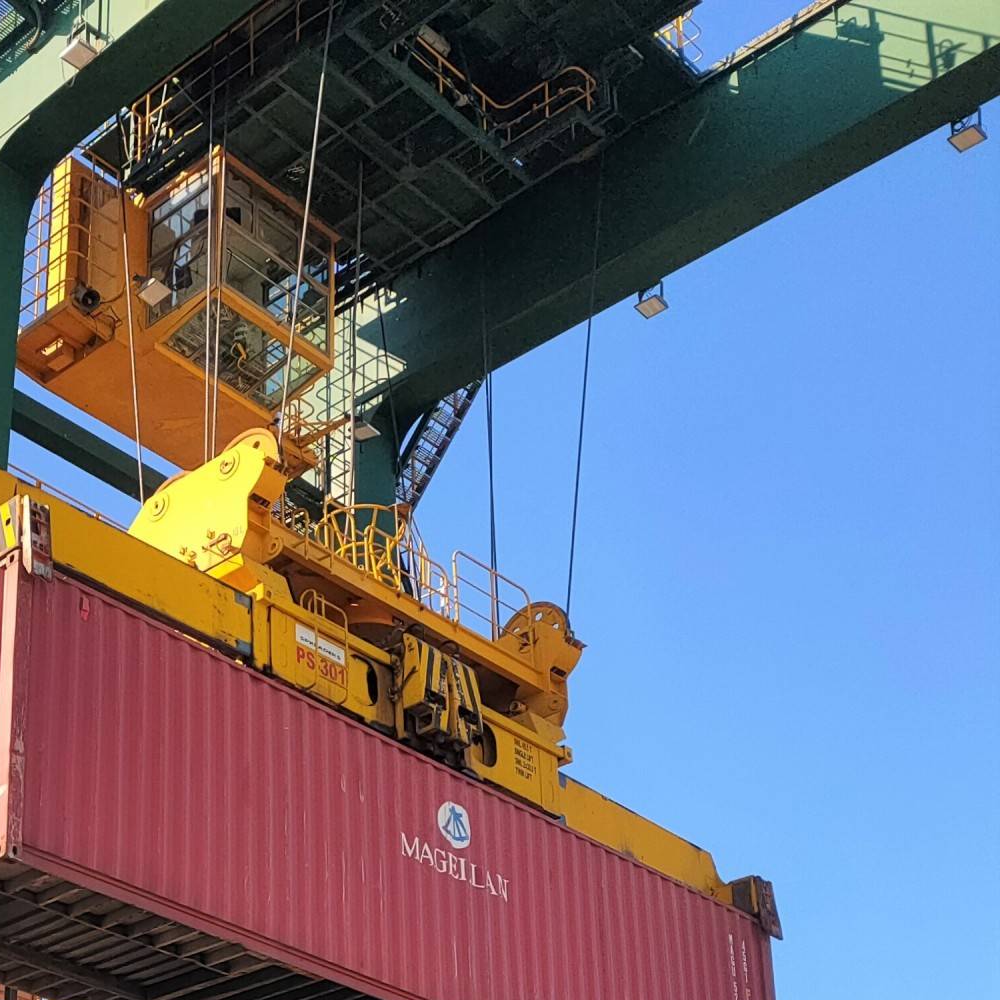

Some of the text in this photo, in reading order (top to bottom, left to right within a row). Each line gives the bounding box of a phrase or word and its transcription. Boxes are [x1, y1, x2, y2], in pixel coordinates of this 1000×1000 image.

[296, 645, 345, 685] PS 301
[401, 832, 510, 903] MAGELLAN
